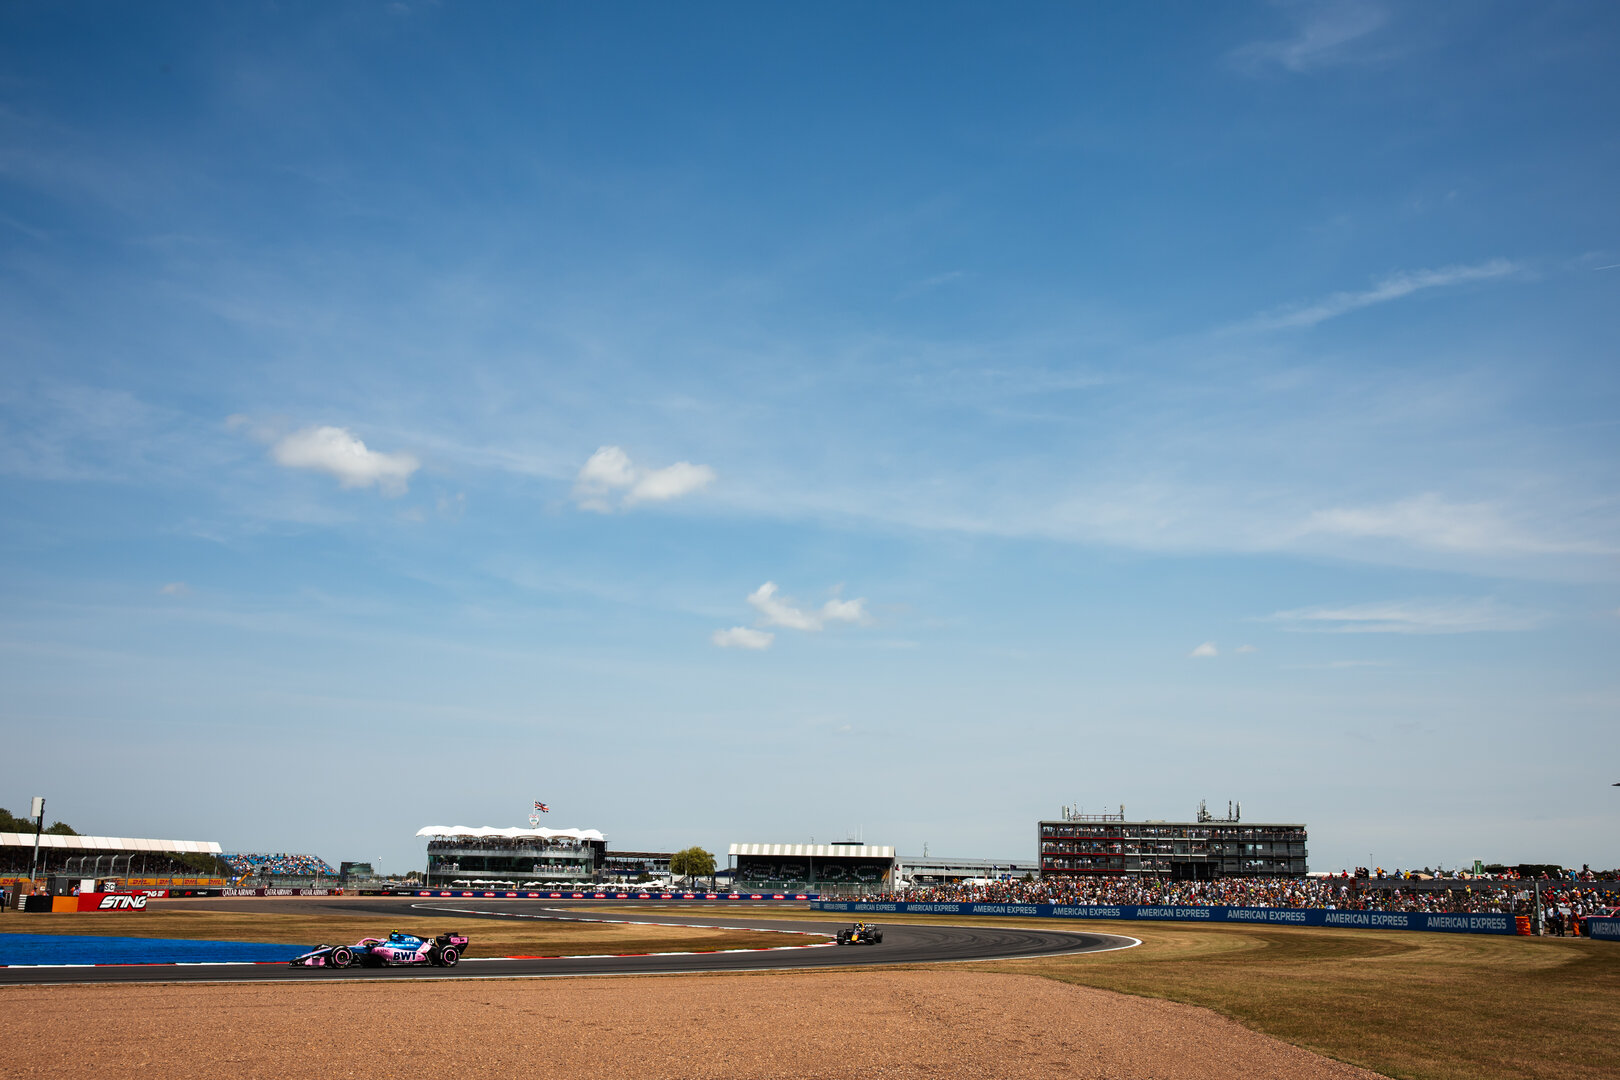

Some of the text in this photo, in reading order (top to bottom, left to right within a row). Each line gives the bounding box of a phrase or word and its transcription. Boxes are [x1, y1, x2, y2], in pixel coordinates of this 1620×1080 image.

[98, 894, 147, 909] STING
[907, 904, 959, 913] AMERICAN EXPRESS
[973, 905, 1037, 915] AMERICAN EXPRESS
[1053, 907, 1120, 917] AMERICAN EXPRESS
[1137, 908, 1210, 919] AMERICAN EXPRESS
[1227, 909, 1306, 922] AMERICAN EXPRESS
[1325, 913, 1408, 927] AMERICAN EXPRESS
[1427, 916, 1507, 930] AMERICAN EXPRESS
[393, 951, 417, 961] BWT
